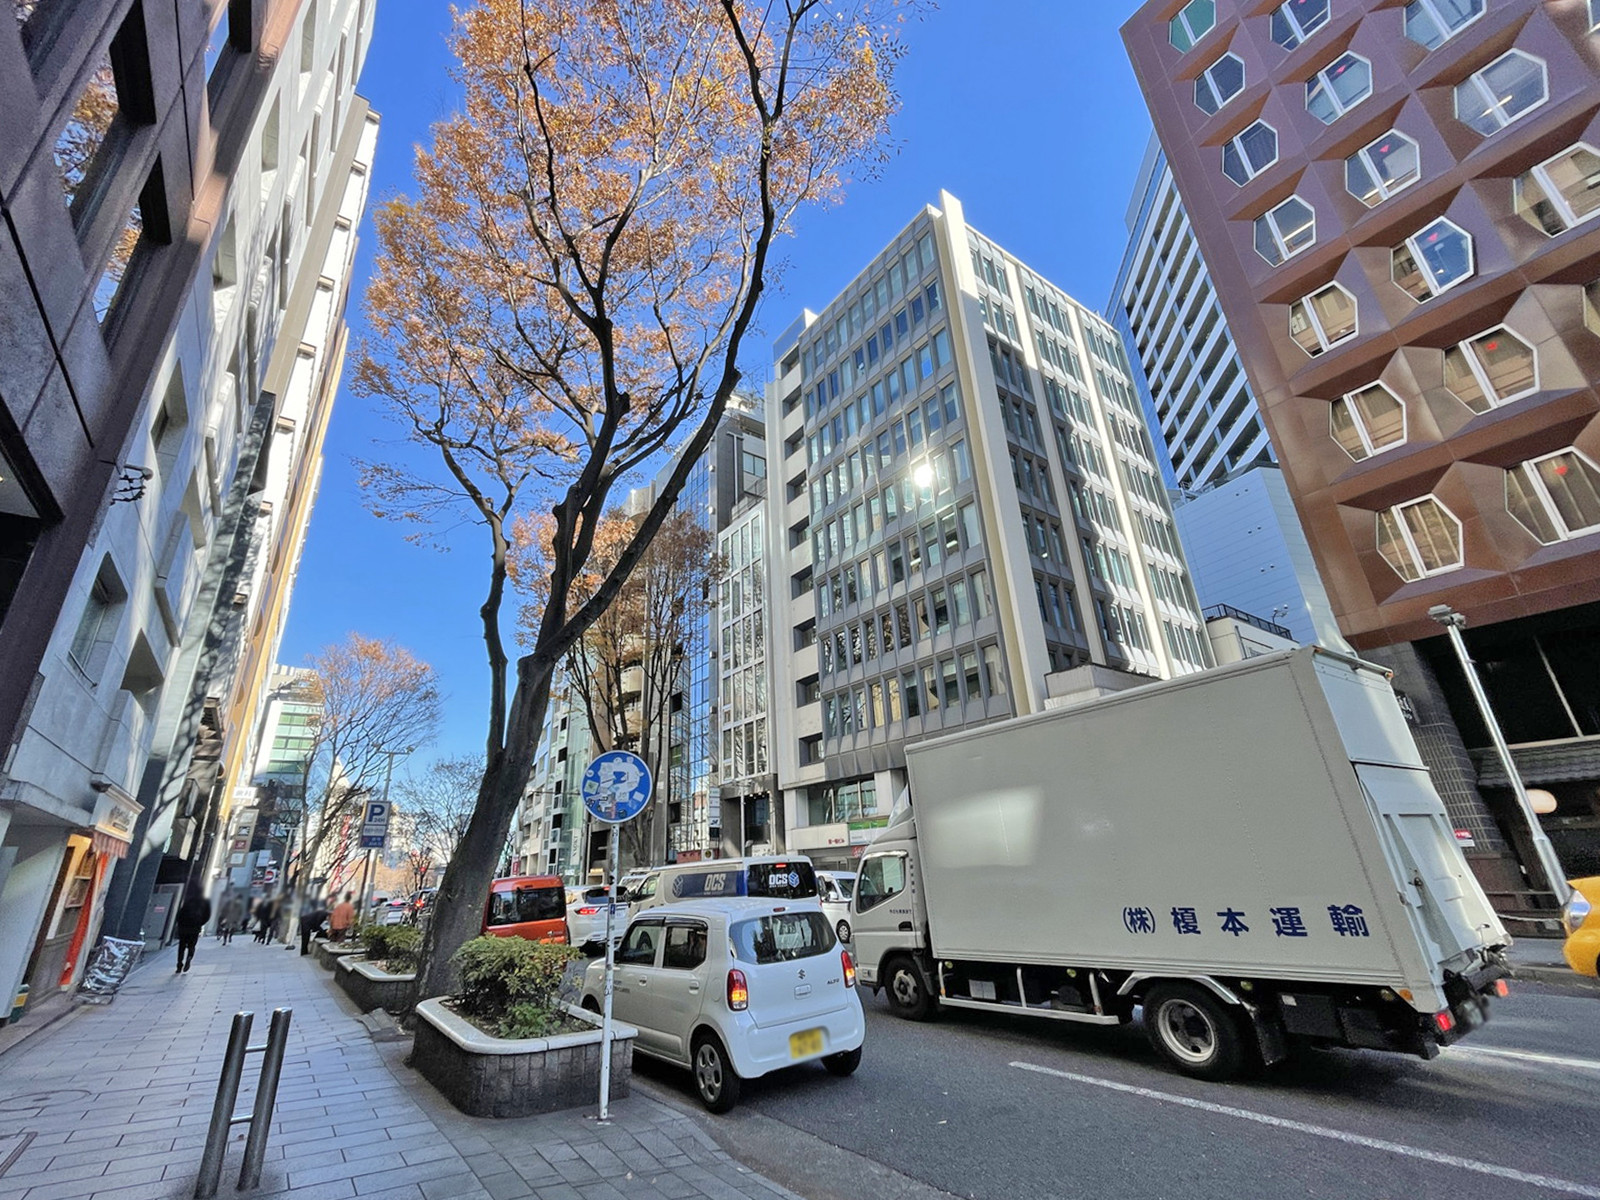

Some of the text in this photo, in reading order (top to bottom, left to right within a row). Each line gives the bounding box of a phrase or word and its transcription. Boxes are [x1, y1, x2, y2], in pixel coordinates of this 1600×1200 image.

[368, 804, 385, 822] P
[704, 873, 726, 891] OCS
[768, 873, 788, 885] OCS
